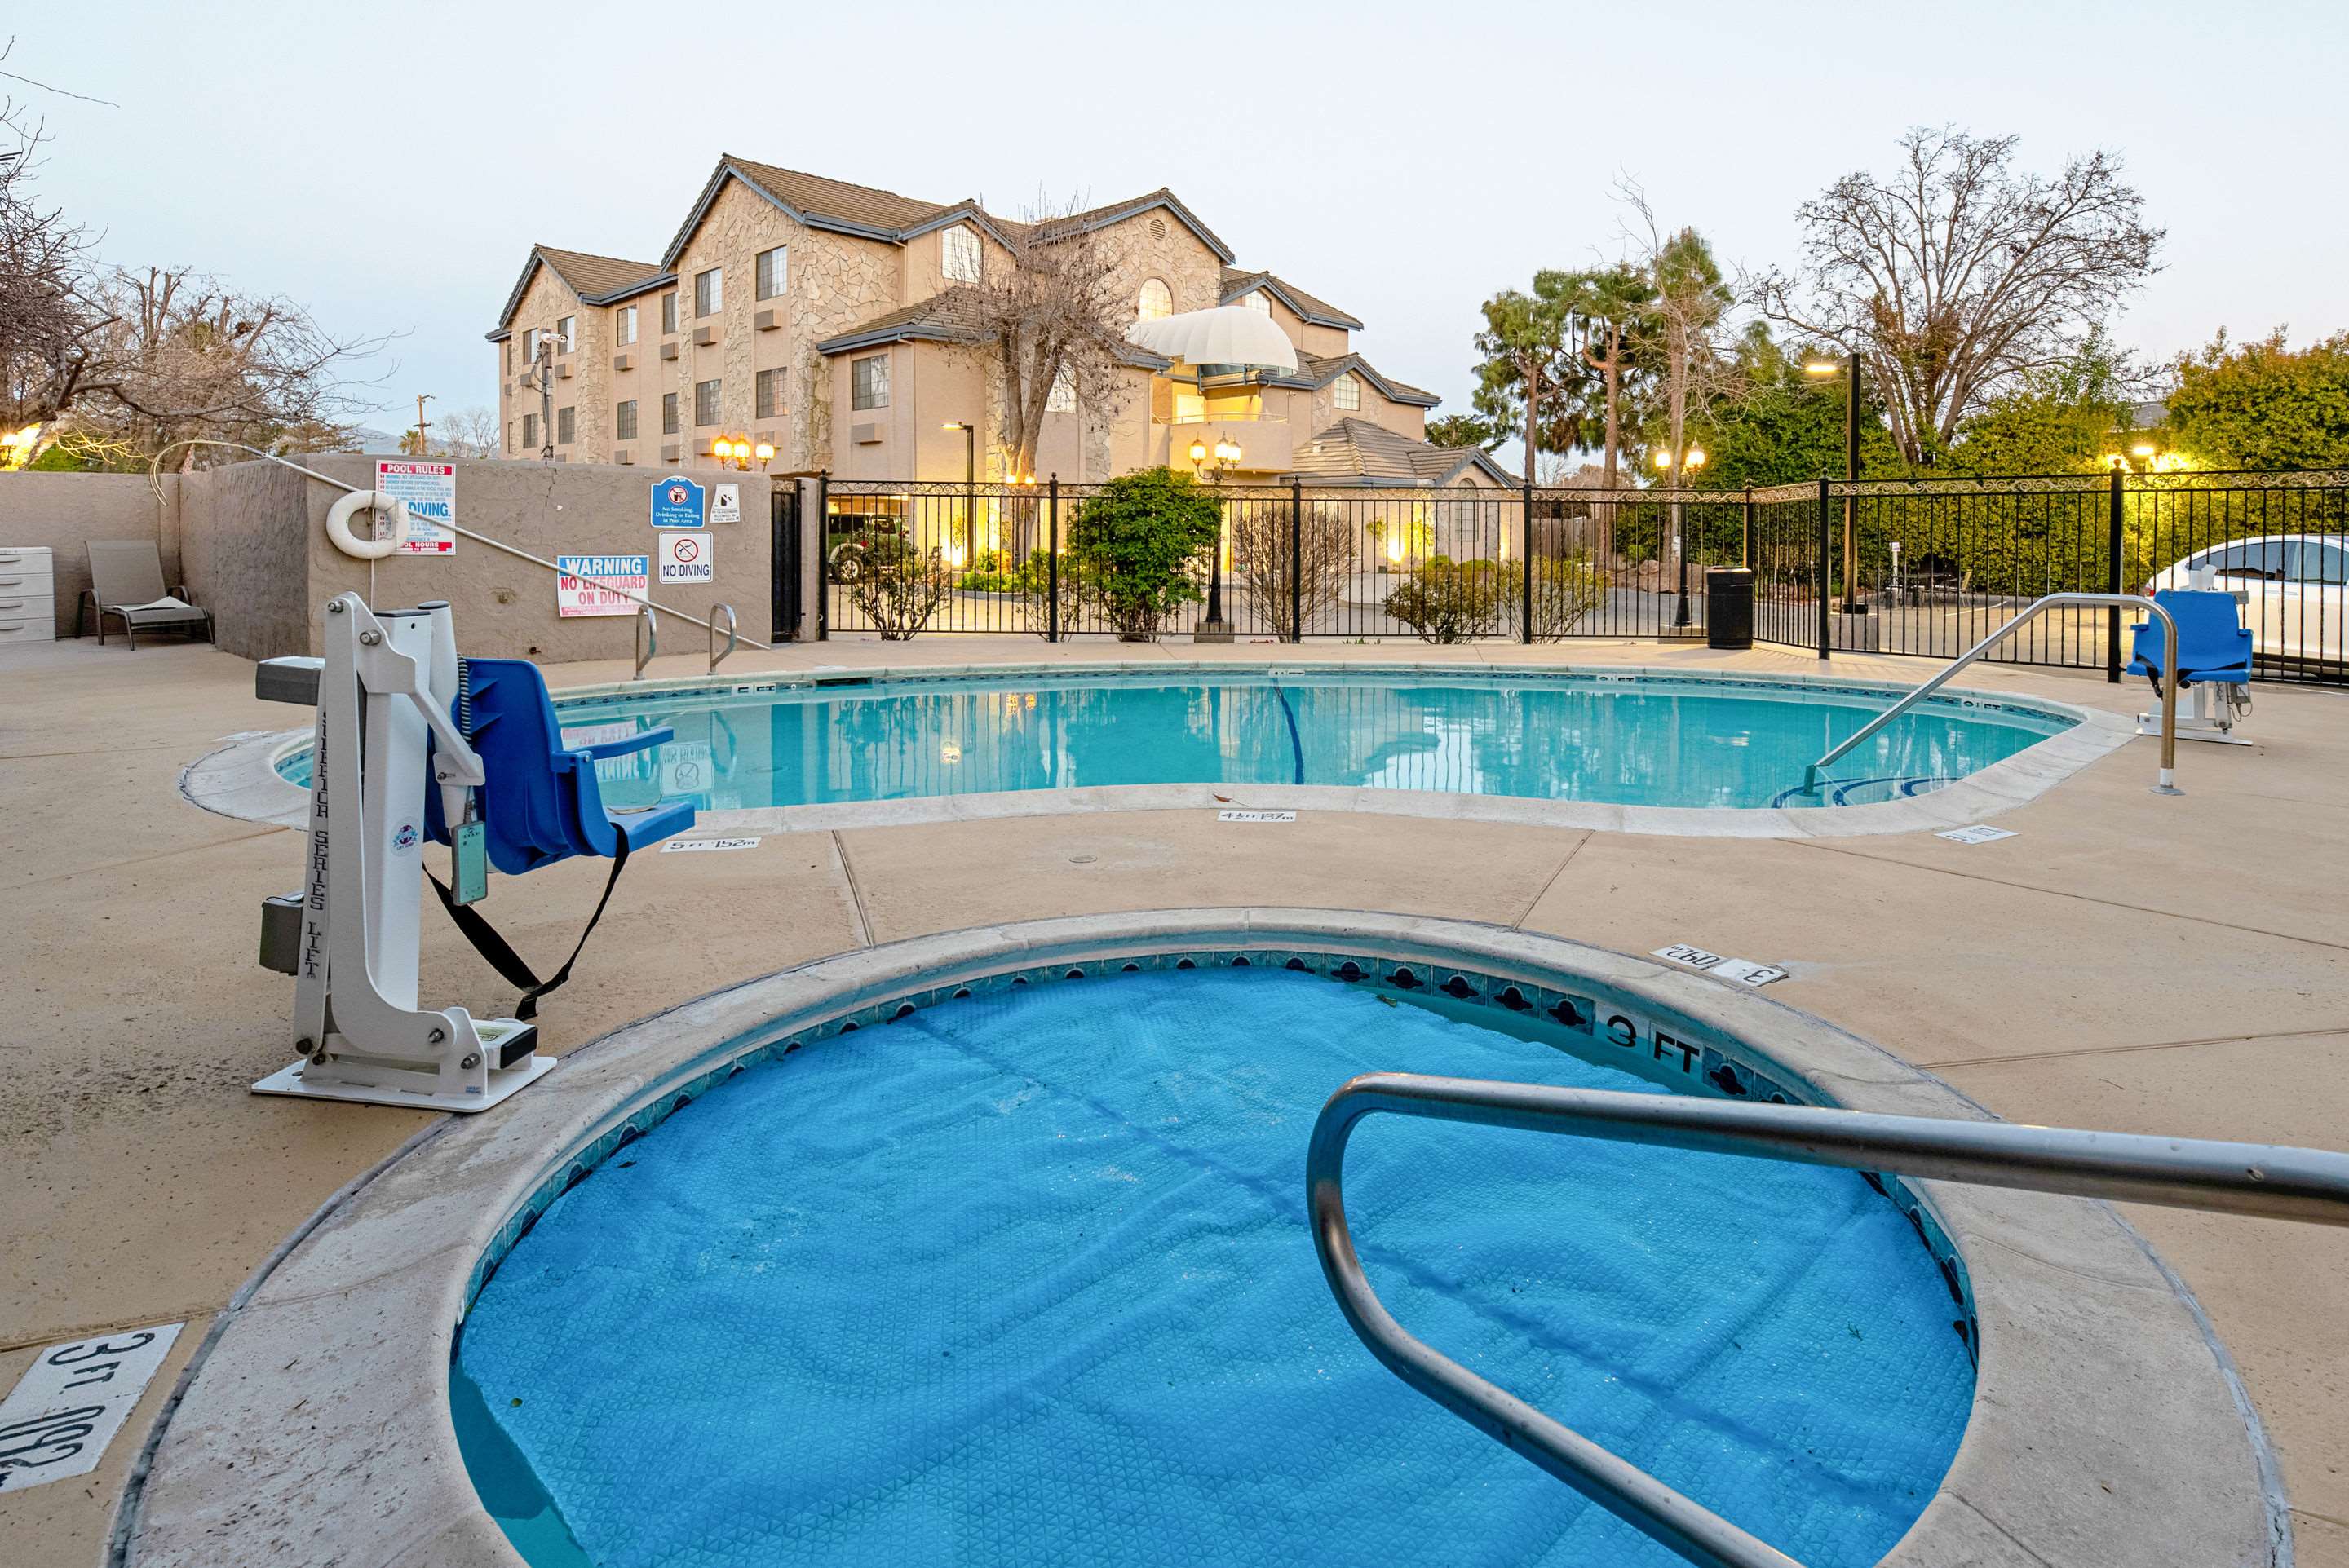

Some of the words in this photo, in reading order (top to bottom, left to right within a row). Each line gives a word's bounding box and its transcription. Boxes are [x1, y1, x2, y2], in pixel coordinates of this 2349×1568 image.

[387, 464, 412, 473] POOL
[416, 465, 445, 475] RULES
[565, 558, 642, 575] WARNING
[663, 564, 676, 577] NO
[679, 564, 710, 576] DIVING
[560, 576, 577, 590] NO
[578, 591, 595, 604] ON
[670, 841, 685, 850] 5
[310, 830, 329, 911] SERIES
[1606, 1014, 1637, 1048] 3
[1653, 1031, 1700, 1074] FT
[46, 1332, 156, 1366] 3
